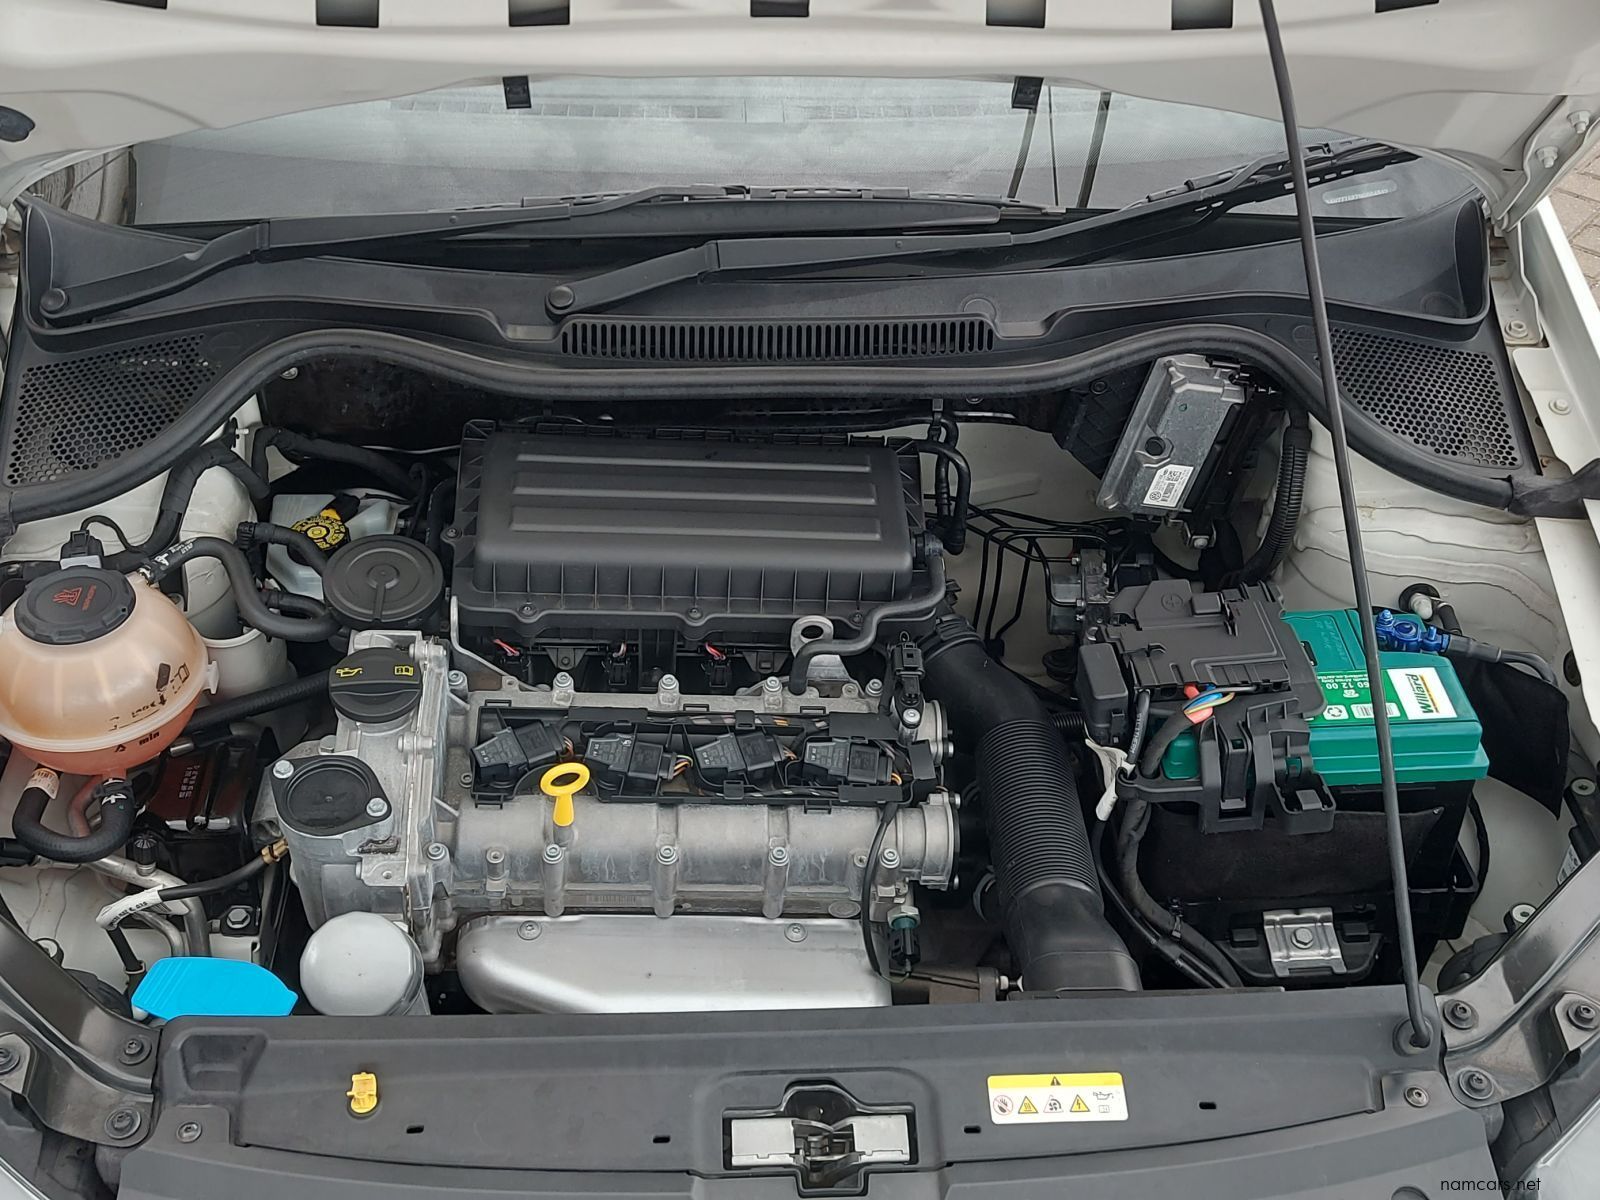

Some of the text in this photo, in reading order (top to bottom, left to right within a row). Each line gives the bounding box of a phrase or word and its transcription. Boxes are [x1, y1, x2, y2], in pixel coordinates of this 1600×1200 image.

[1325, 682, 1339, 690] 00
[1341, 681, 1354, 689] 12
[1405, 673, 1434, 714] Willard
[139, 731, 160, 746] min
